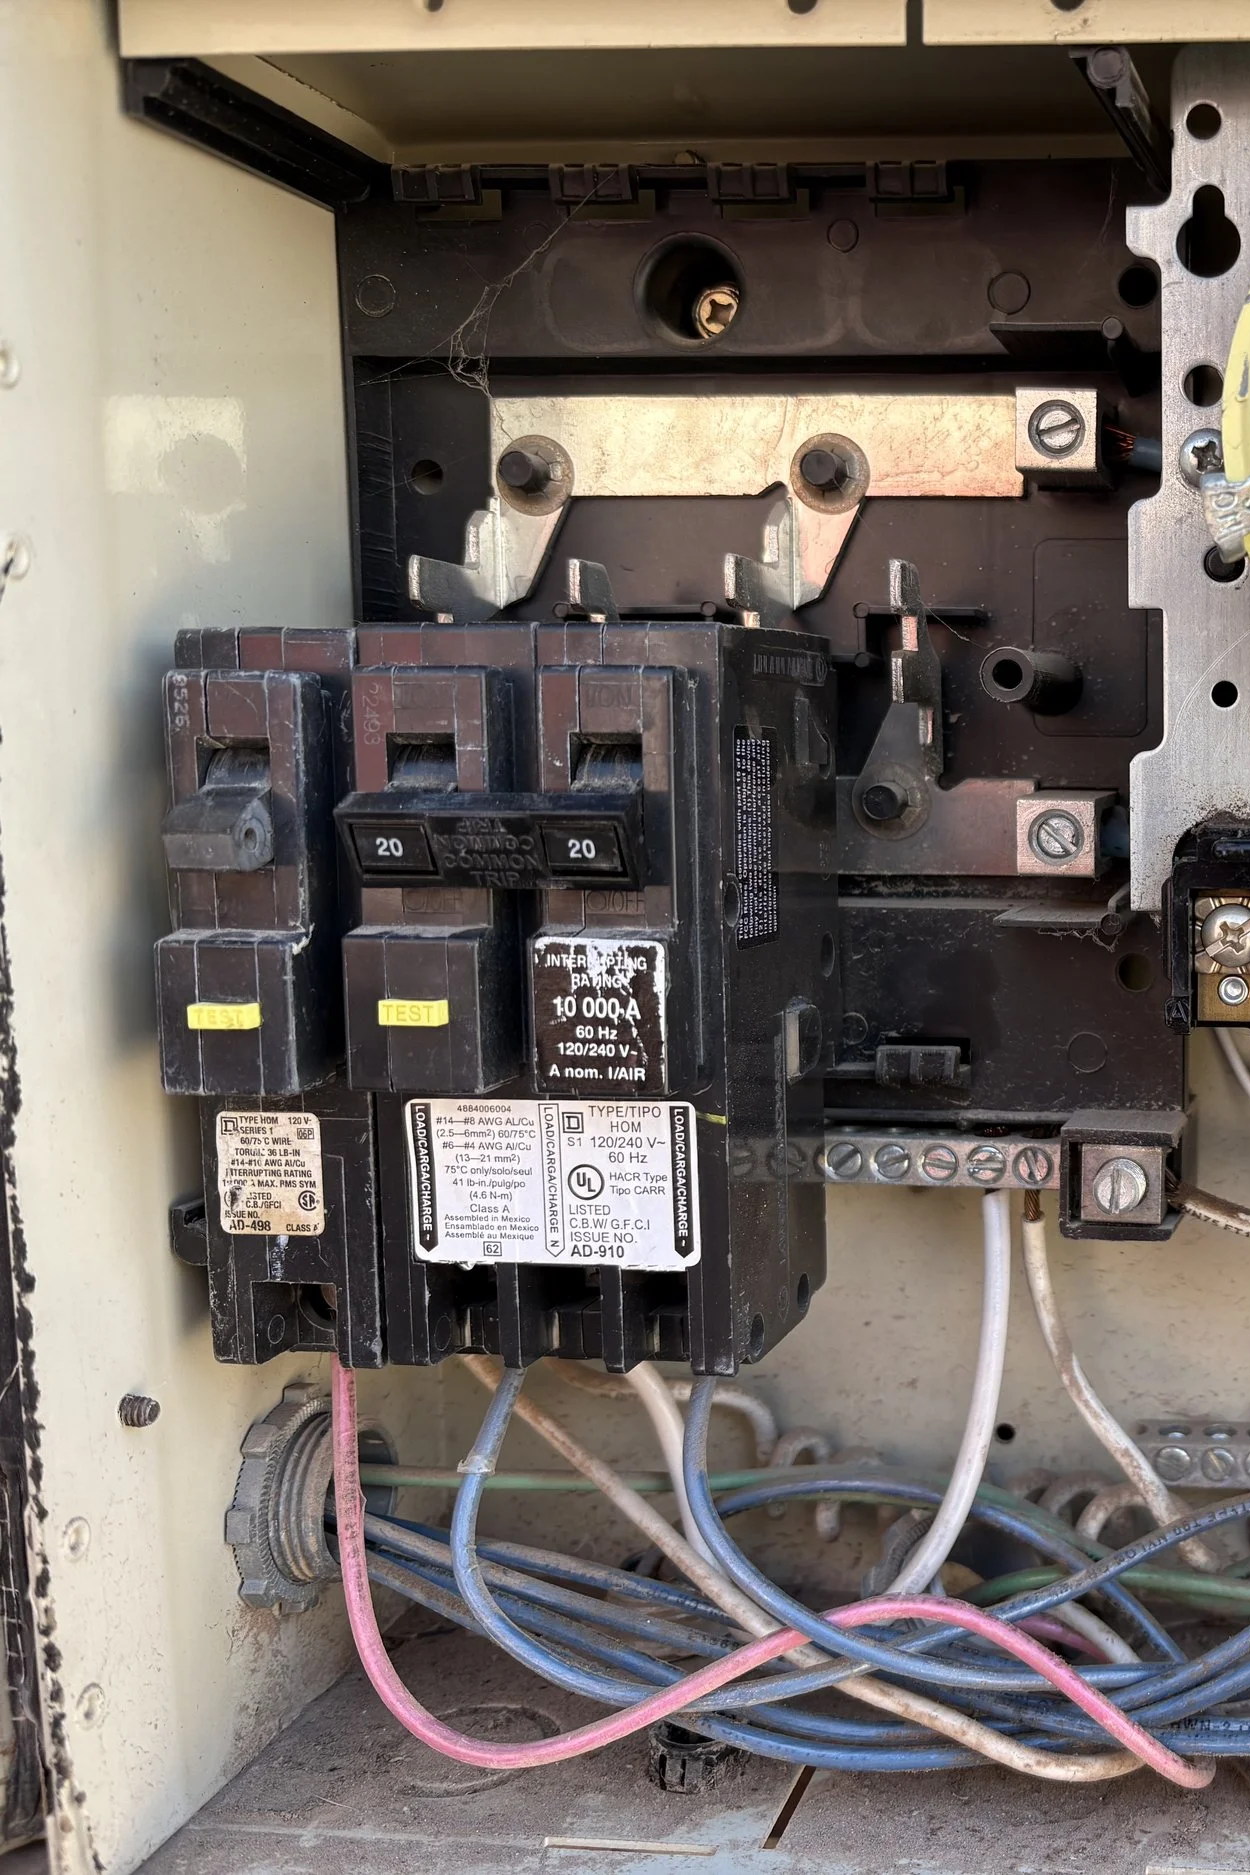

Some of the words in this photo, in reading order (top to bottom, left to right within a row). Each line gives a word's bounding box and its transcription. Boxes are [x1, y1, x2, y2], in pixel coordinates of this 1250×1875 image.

[376, 838, 403, 857] 20
[568, 839, 596, 858] 20
[443, 854, 542, 870] COMMON
[470, 871, 520, 886] TRIP
[547, 954, 647, 970] INTERPTING
[553, 996, 576, 1016] 10
[583, 997, 620, 1018] 000
[625, 998, 641, 1019] A
[194, 1008, 244, 1027] TEST
[382, 1004, 435, 1023] TEST
[576, 1026, 594, 1039] 60
[598, 1026, 618, 1040] Hz
[558, 1042, 616, 1056] 120/240
[549, 1064, 560, 1076] A
[565, 1067, 602, 1079] nom.
[588, 1106, 661, 1118] TYPE/TIPO
[239, 1116, 258, 1124] TYPE
[261, 1116, 278, 1124] HOM
[478, 1117, 503, 1126] AWG
[610, 1121, 641, 1132] HOM
[272, 1137, 292, 1145] WIRE
[478, 1142, 503, 1150] AWG
[567, 1137, 582, 1146] S1
[590, 1137, 643, 1148] 120/240
[279, 1149, 300, 1157] LB-IN
[609, 1152, 624, 1163] 60
[629, 1152, 648, 1163] Hz
[264, 1159, 282, 1167] AWG
[415, 1106, 432, 1231] LOAD/CARGA/CHARGE
[284, 1169, 312, 1178] RATING
[444, 1166, 468, 1174] 75°C
[470, 1166, 533, 1177] only/solo/seul
[543, 1107, 558, 1234] LOAD/CARGA/CHARGE
[674, 1109, 689, 1237] LOAD/CARGA/CHARGE
[453, 1179, 463, 1187] 41
[609, 1172, 640, 1181] HACR
[644, 1173, 668, 1183] Type
[258, 1180, 278, 1188] MAX.
[299, 1180, 316, 1188] SYM
[470, 1191, 487, 1201] (4.6
[490, 1191, 513, 1201] N-m)
[610, 1185, 630, 1196] Tipo
[634, 1186, 665, 1195] CARR
[470, 1204, 499, 1213] Class
[502, 1205, 511, 1213] A
[569, 1205, 610, 1215] LISTED
[444, 1214, 490, 1222] Assembled
[501, 1215, 531, 1223] Mexico
[229, 1220, 271, 1231] AD-498
[286, 1224, 311, 1232] CLASS
[445, 1223, 494, 1231] Ensamblado
[510, 1224, 539, 1232] Mexico
[445, 1231, 485, 1239] Assemblé
[500, 1232, 534, 1240] Mexique
[570, 1232, 610, 1242] ISSUE
[613, 1232, 637, 1243] NO.
[486, 1244, 499, 1254] 62
[571, 1245, 625, 1258] AD-910
